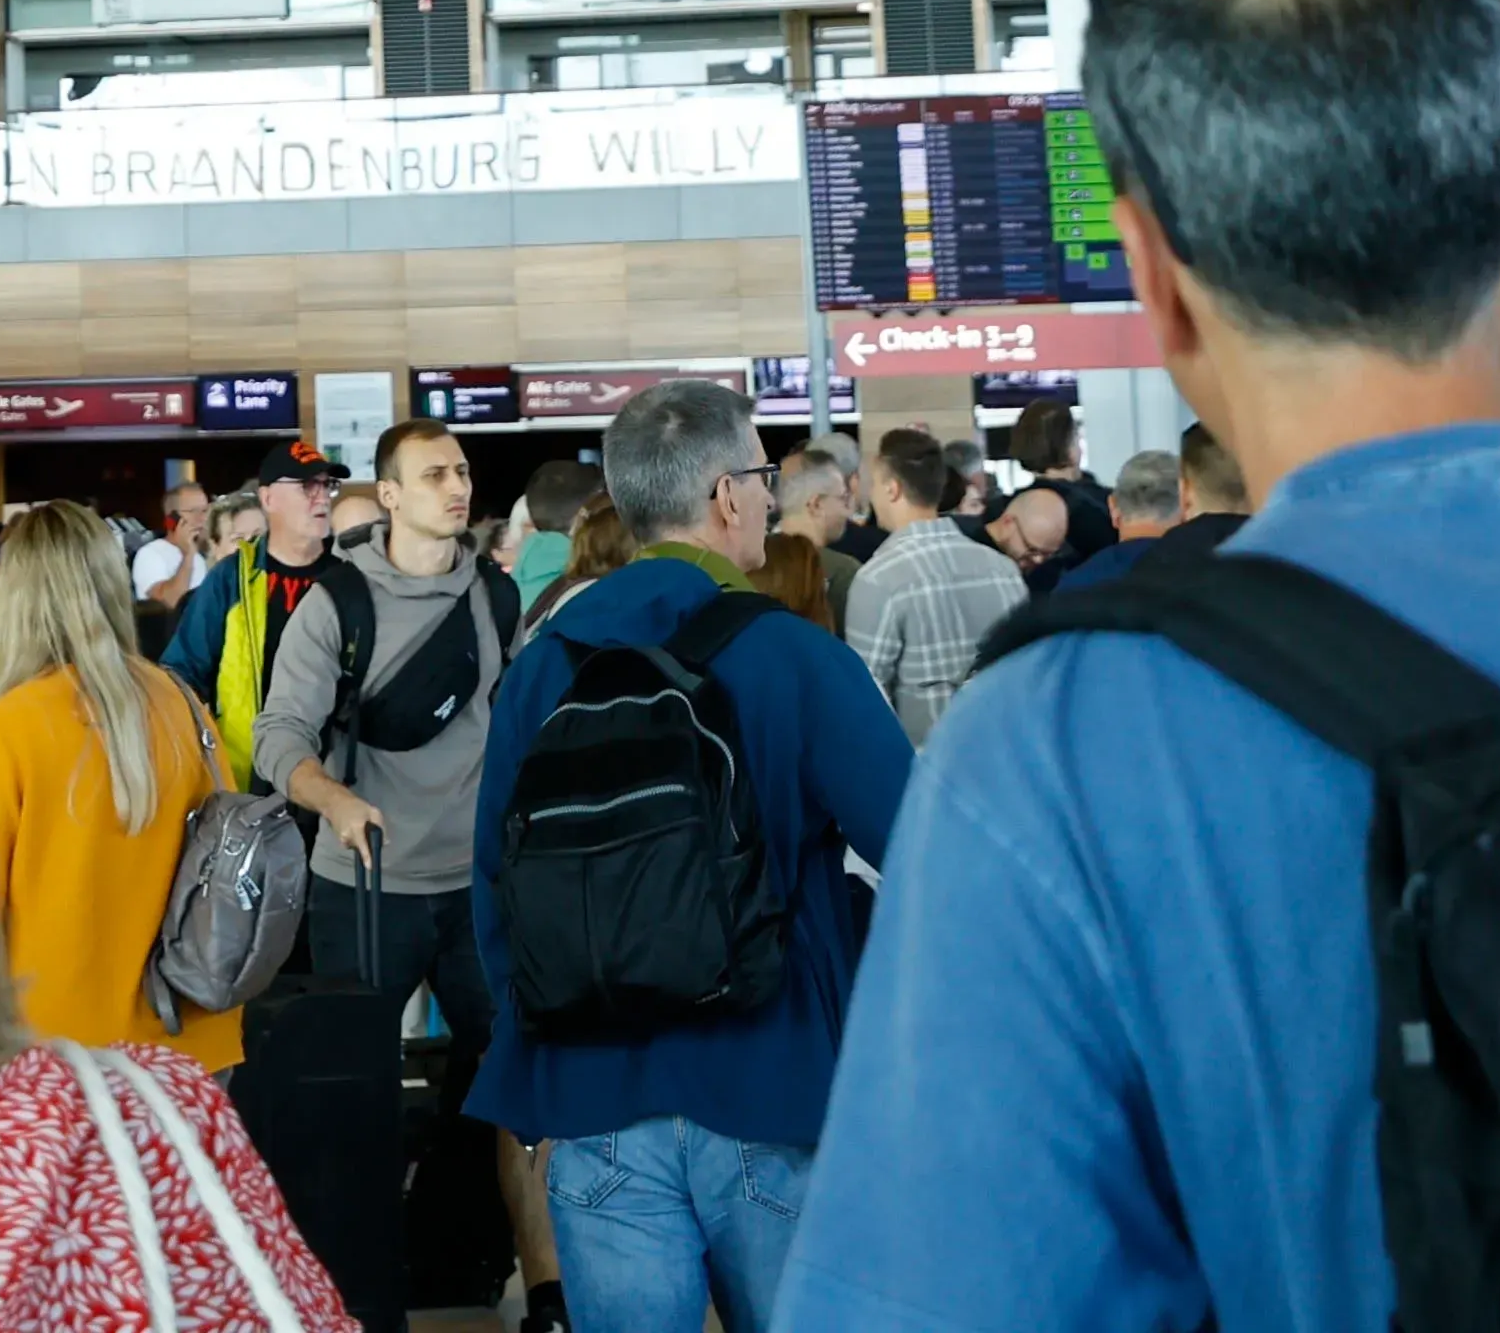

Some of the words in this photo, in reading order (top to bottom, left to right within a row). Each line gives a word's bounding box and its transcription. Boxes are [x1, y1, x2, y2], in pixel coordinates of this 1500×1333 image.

[879, 326, 982, 351] Check-in
[235, 380, 287, 395] Priority
[554, 381, 591, 395] Gates
[11, 396, 46, 409] Gates
[235, 396, 269, 409] Lane
